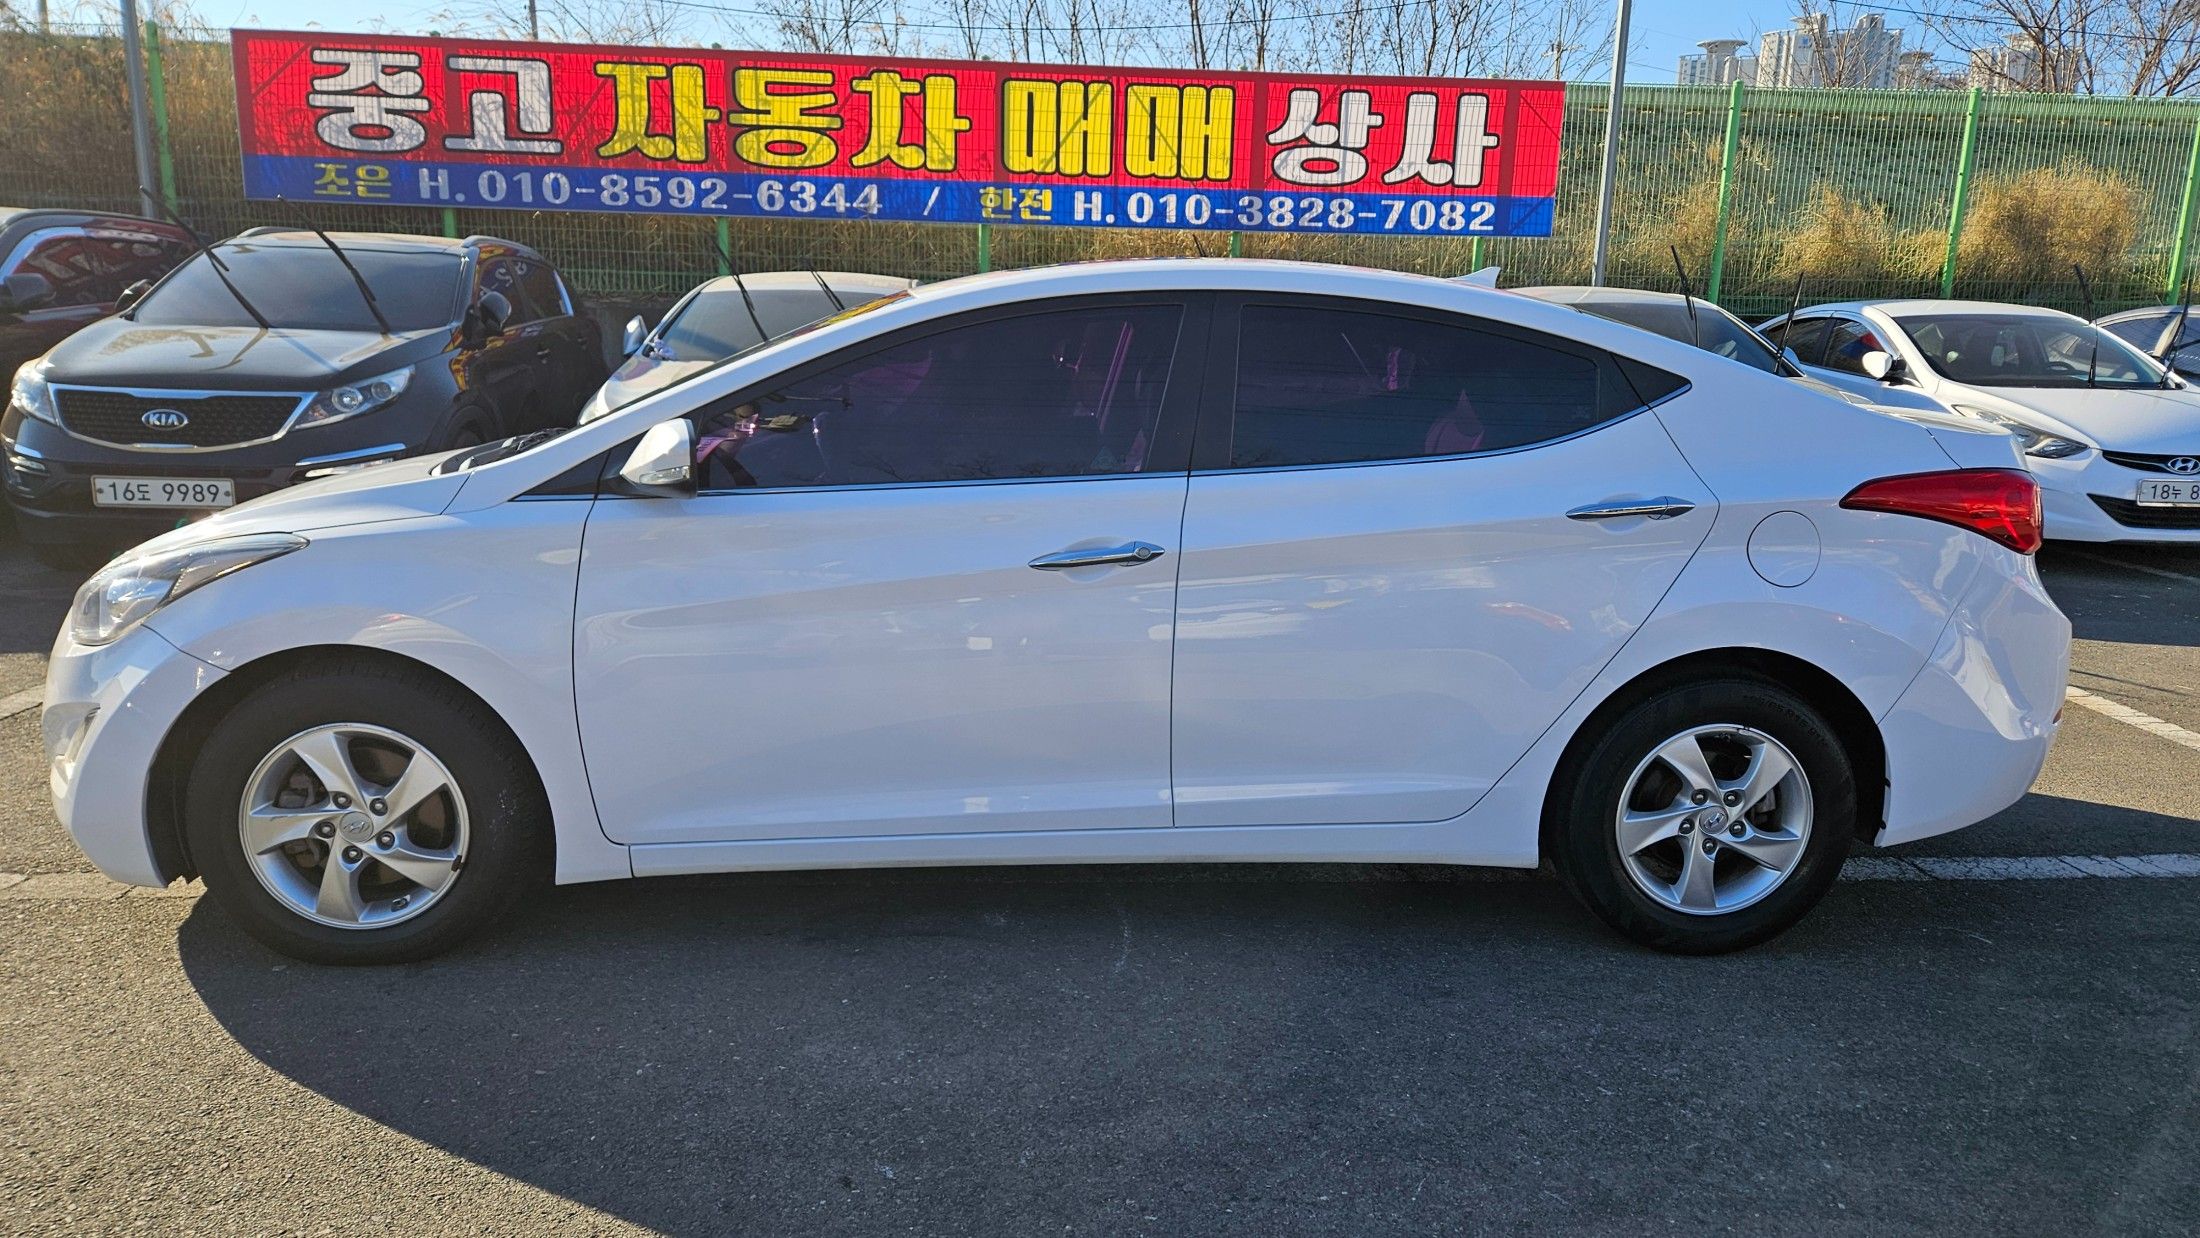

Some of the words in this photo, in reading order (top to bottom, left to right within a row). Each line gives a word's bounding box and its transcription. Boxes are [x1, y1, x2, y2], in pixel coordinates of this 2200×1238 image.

[308, 49, 564, 154] 중고
[594, 61, 972, 172] 자동차
[1002, 79, 1236, 180] 매매
[1266, 88, 1499, 187] 상사
[313, 162, 392, 199] 조은
[979, 186, 1052, 221] 한전
[148, 413, 179, 426] KIA
[108, 482, 151, 501] 16도
[162, 483, 219, 502] 9989
[2151, 484, 2181, 500] 18누
[2190, 485, 2200, 500] 8
